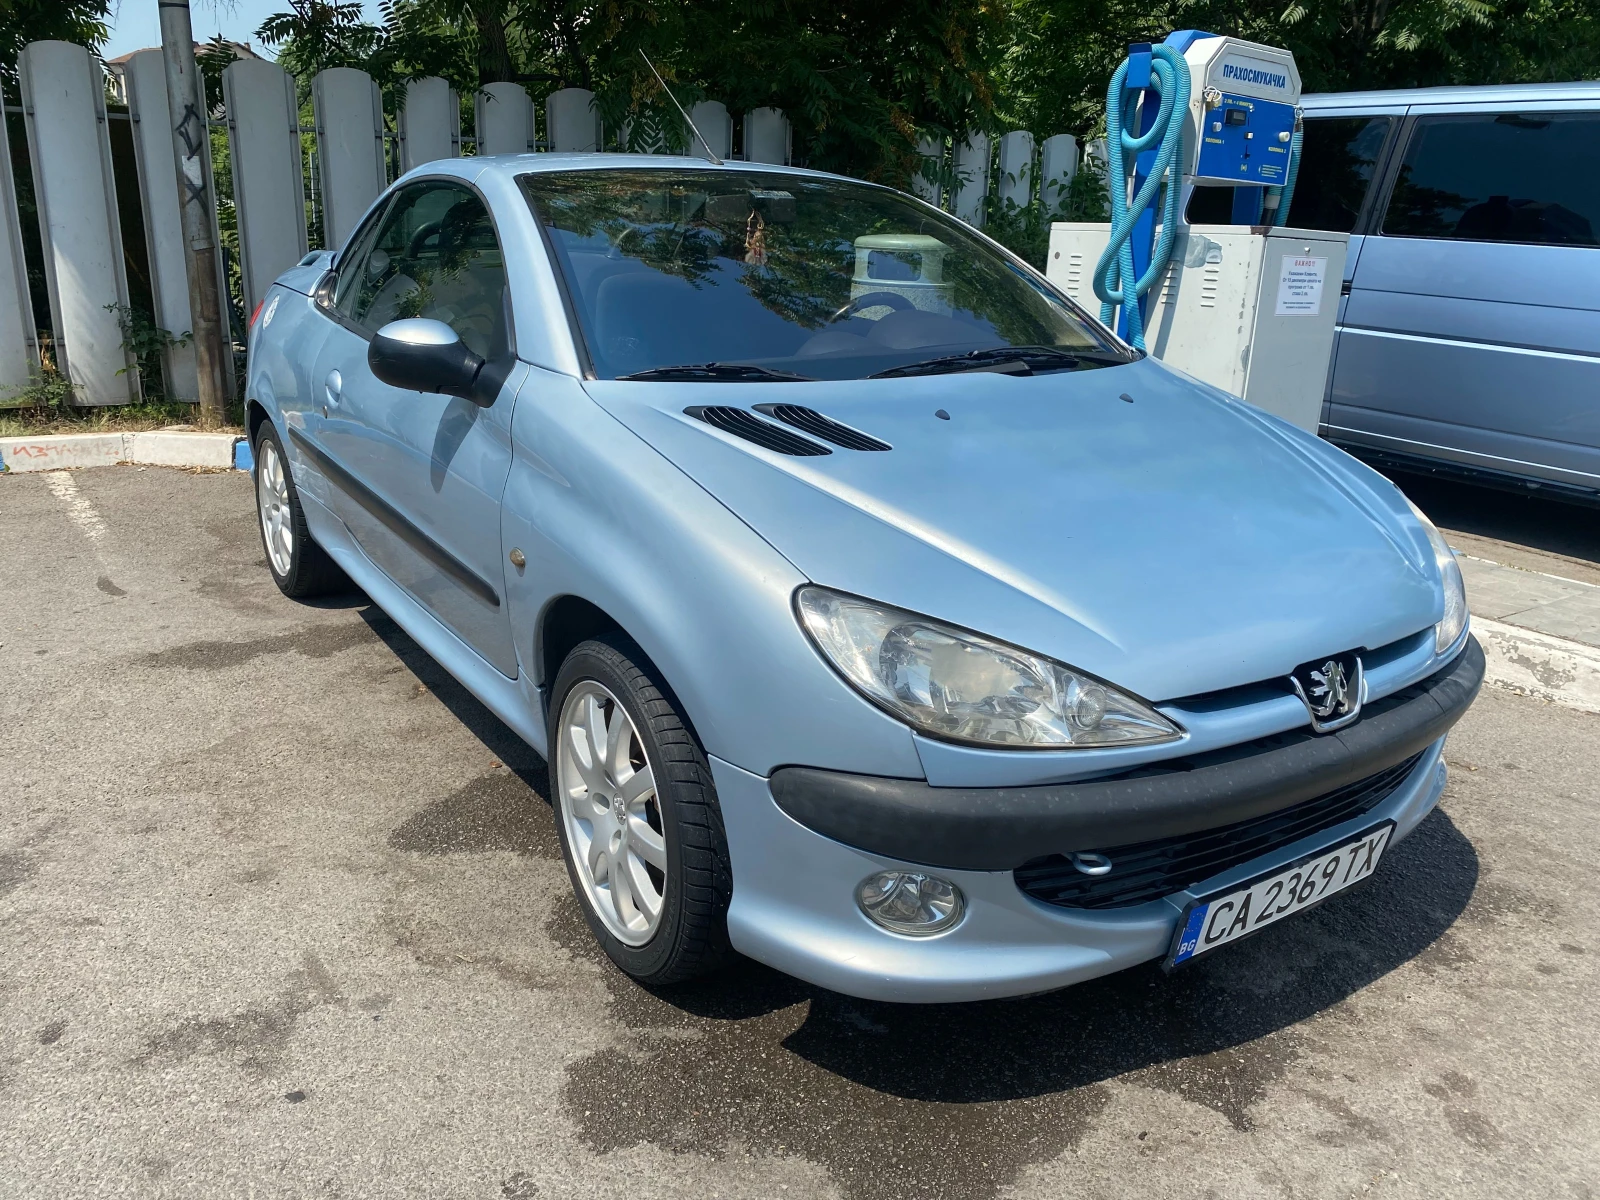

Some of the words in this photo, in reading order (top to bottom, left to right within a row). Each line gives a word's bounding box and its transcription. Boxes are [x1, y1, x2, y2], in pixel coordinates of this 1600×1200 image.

[1223, 64, 1286, 88] ПРАХОСМУКАЧКА
[1204, 892, 1252, 945] CA
[1254, 855, 1341, 925] 2369
[1343, 833, 1386, 884] TX
[1178, 938, 1196, 956] BG
